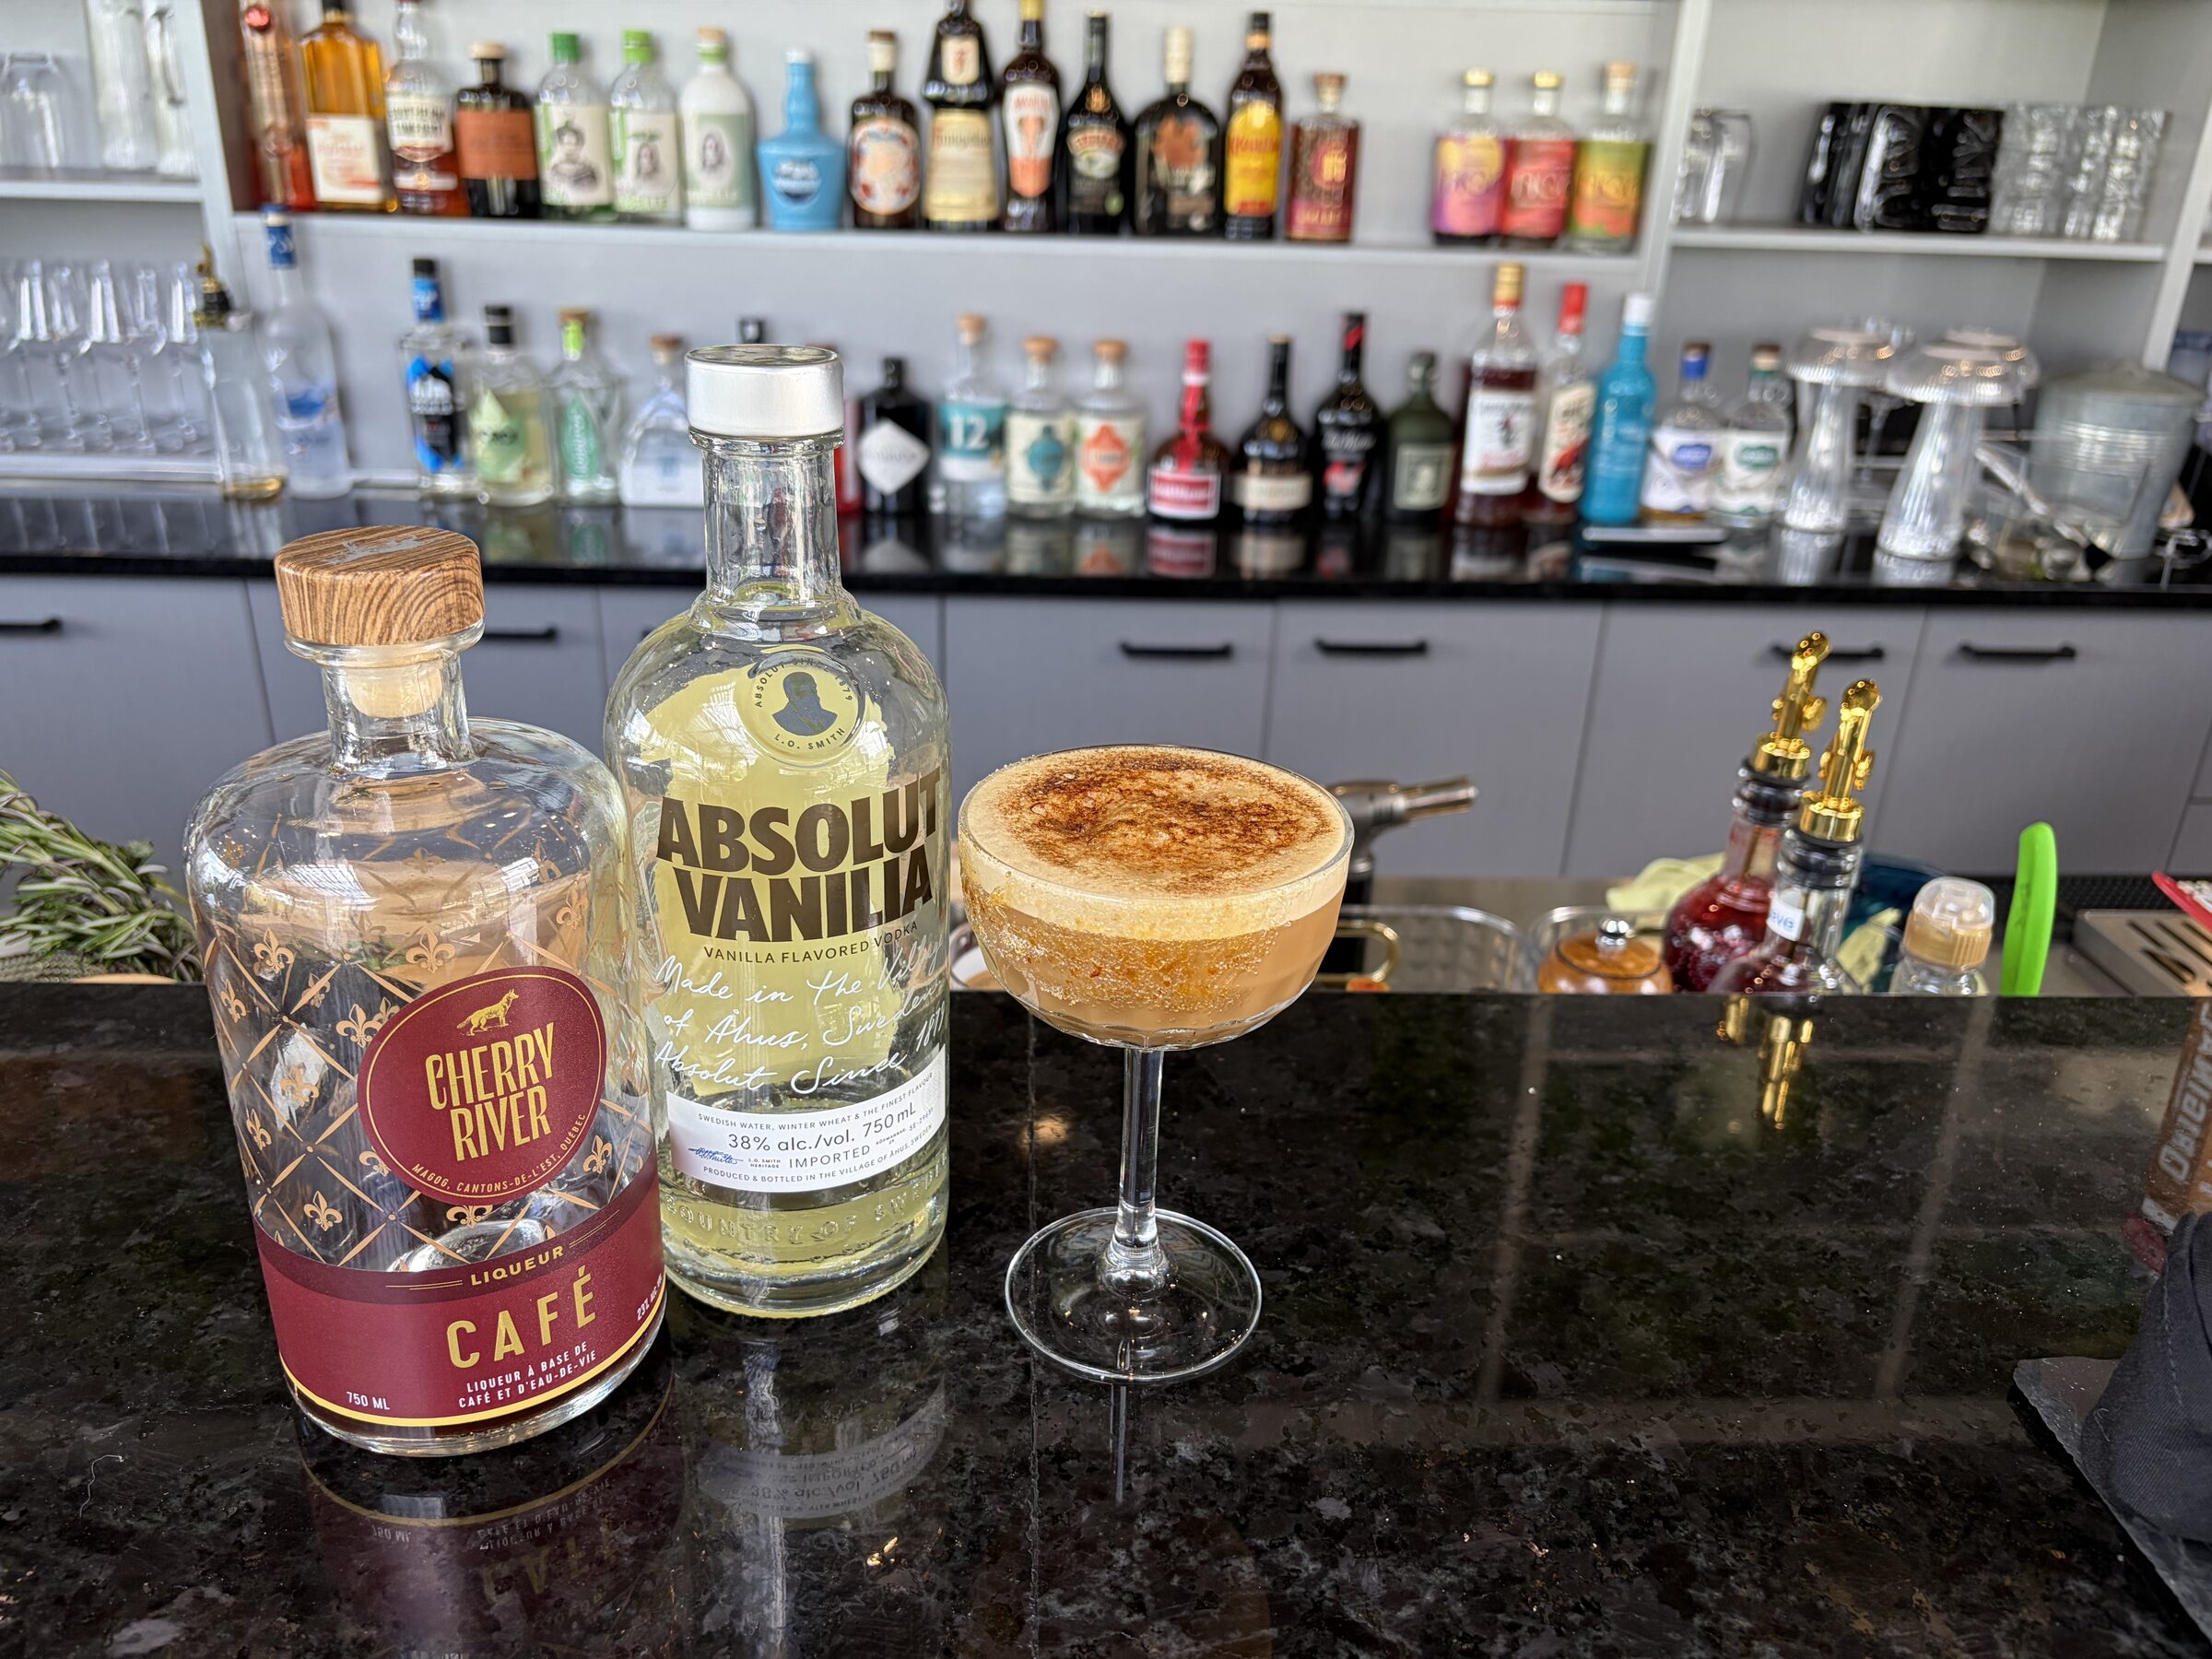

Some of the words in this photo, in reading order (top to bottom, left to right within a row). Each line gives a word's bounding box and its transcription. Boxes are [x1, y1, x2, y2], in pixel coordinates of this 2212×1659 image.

[948, 418, 989, 450] 12
[755, 662, 785, 708] ABSOLUT
[835, 675, 853, 701] 1879
[774, 734, 800, 749] L.O.
[807, 727, 845, 750] SMITH
[656, 768, 940, 876] ABSOLUT
[673, 844, 933, 943] VANILIA
[704, 947, 775, 964] VANILLA
[782, 941, 869, 963] FLAVORED
[874, 921, 918, 947] VODKA
[655, 955, 734, 1000] Made
[745, 985, 794, 1004] in
[806, 970, 863, 1006] the
[664, 1008, 694, 1038] of
[704, 1008, 808, 1050] Åhus,
[425, 1022, 555, 1112] CHERRY
[654, 1040, 778, 1091] Absolut
[790, 1052, 908, 1095] Since
[450, 1085, 552, 1161] RIVER
[698, 1113, 736, 1127] SWEDISH
[740, 1123, 775, 1131] WATER,
[778, 1122, 816, 1130] WINTER
[819, 1115, 852, 1127] WHEAT
[863, 1107, 878, 1117] THE
[881, 1094, 907, 1111] FINEST
[728, 1134, 771, 1152] 38%
[777, 1129, 855, 1152] alc./vol.
[863, 1113, 894, 1138] 750
[897, 1101, 917, 1123] mL
[412, 1163, 451, 1191] MAGOG,
[456, 1154, 561, 1194] CANTONS-DE-L'EST,
[559, 1113, 586, 1151] QUÉBEC
[703, 1166, 749, 1181] PRODUCED
[818, 1171, 836, 1180] THE
[839, 1158, 876, 1176] VILLAGE
[877, 1153, 888, 1164] OF
[911, 1124, 933, 1146] SWEDEN
[789, 1145, 871, 1168] IMPORTED
[819, 1215, 857, 1237] OF
[471, 1246, 564, 1286] LIQUEUR
[447, 1265, 596, 1369] CAFÉ
[458, 1392, 491, 1408] CAFÉ
[497, 1388, 512, 1401] ET
[518, 1350, 596, 1394] D'EAU-DE-VIE
[466, 1371, 521, 1393] LIQUEUR
[528, 1364, 535, 1377] À
[541, 1351, 570, 1371] BASE
[575, 1341, 587, 1356] DE
[347, 1391, 369, 1406] 750
[372, 1396, 391, 1410] ML
